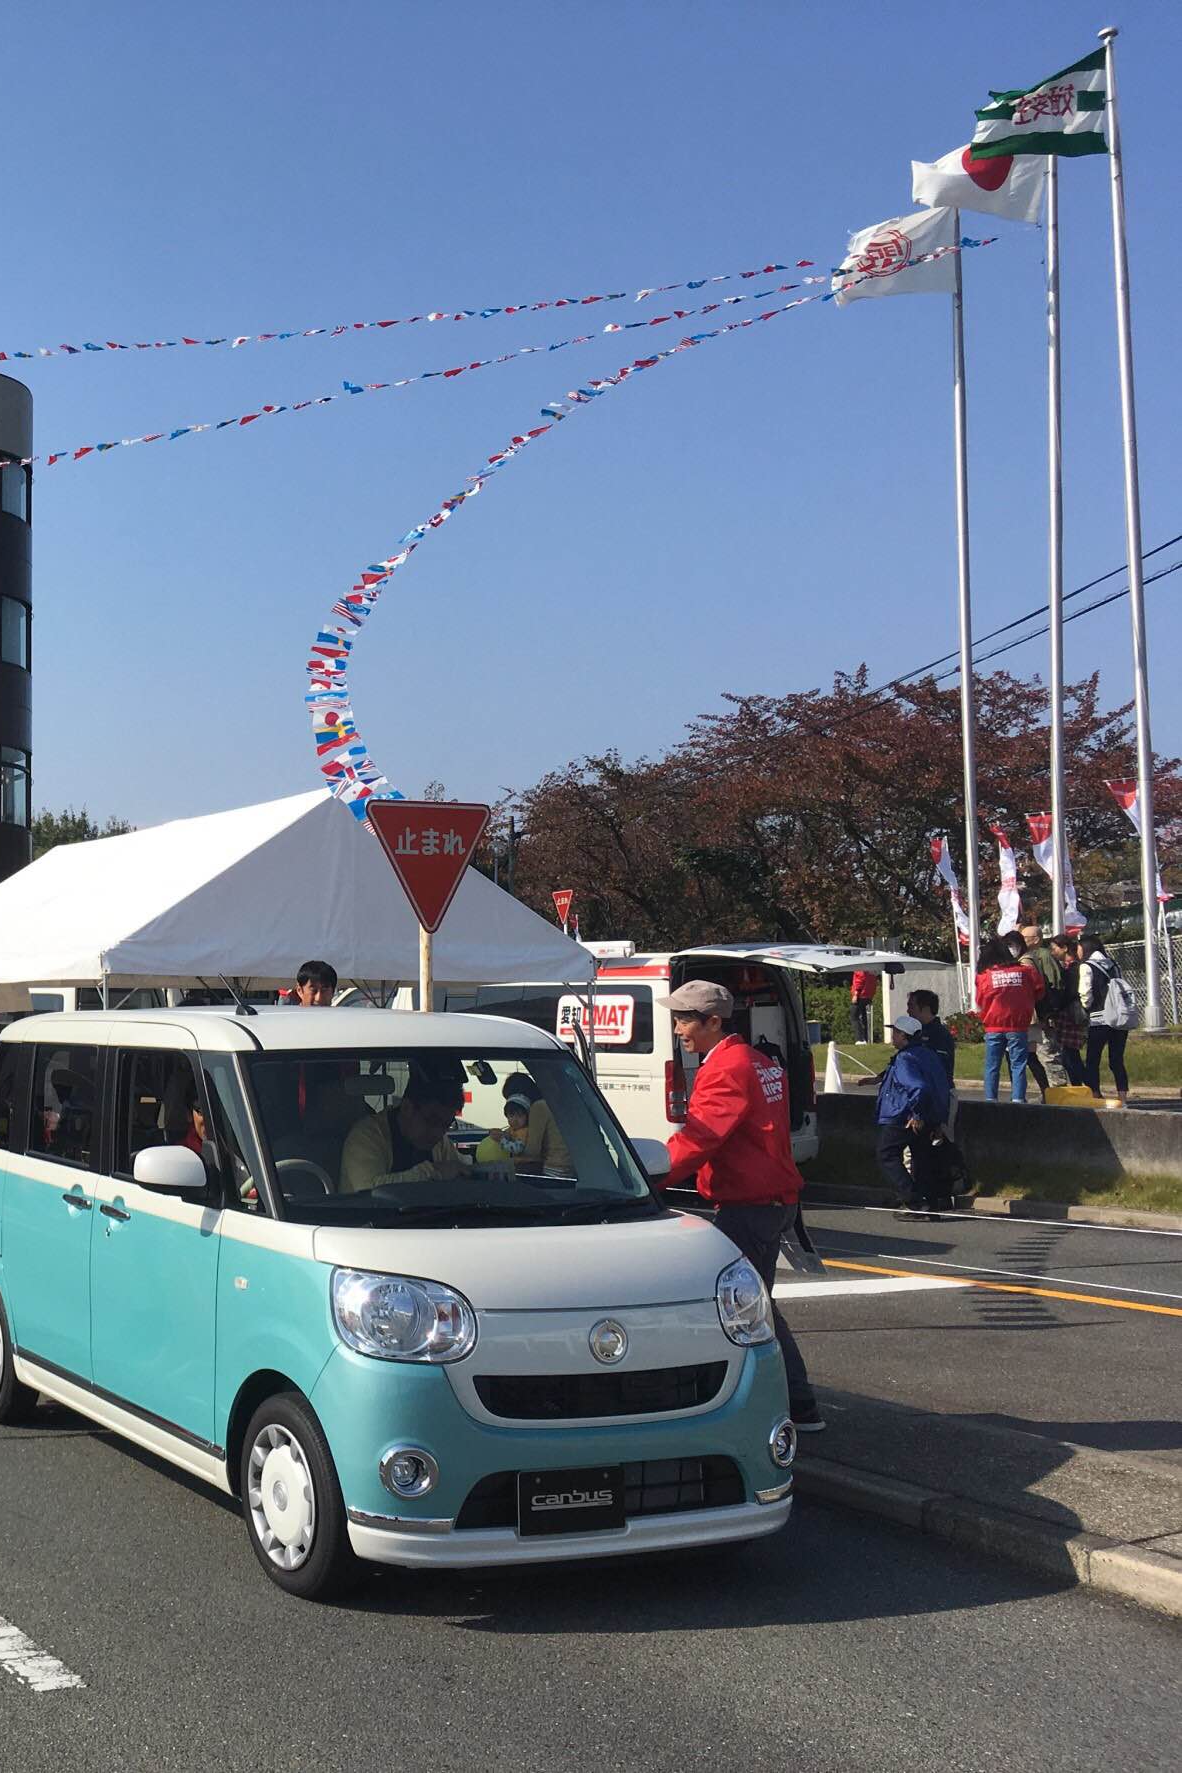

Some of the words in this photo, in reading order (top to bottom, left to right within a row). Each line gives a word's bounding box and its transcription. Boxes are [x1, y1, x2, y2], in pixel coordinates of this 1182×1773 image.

[395, 826, 466, 856] 止まれ
[582, 1005, 629, 1026] DMAT
